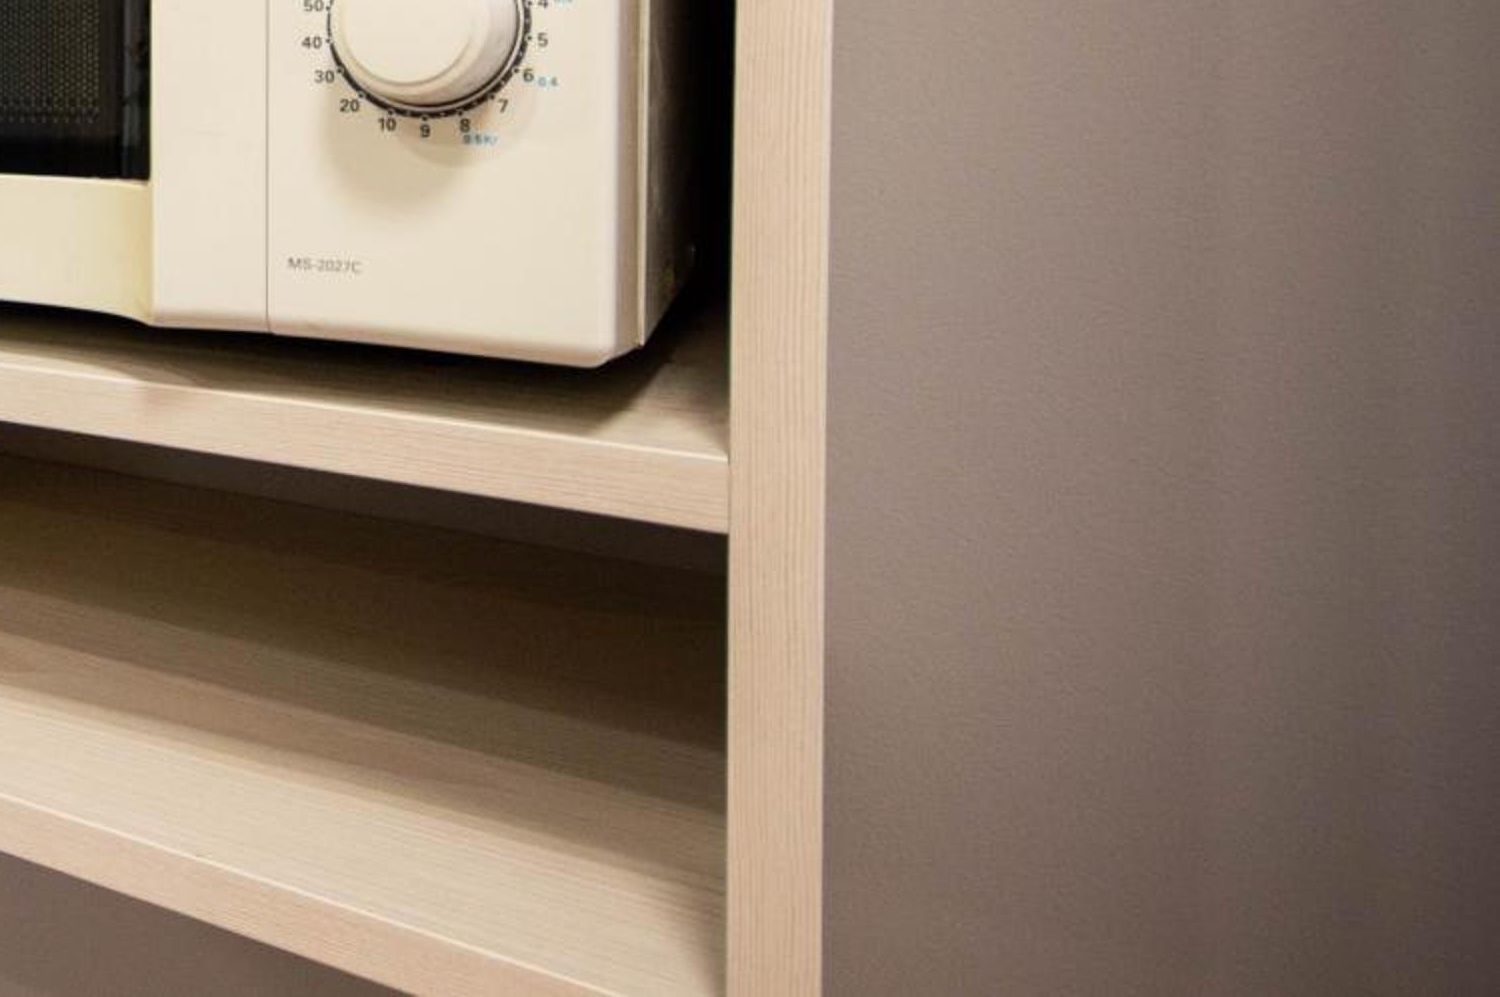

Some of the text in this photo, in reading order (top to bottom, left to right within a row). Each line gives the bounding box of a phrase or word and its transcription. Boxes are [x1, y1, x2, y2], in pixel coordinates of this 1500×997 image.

[302, 36, 322, 49] 40
[538, 33, 548, 47] 5
[314, 70, 335, 83] 30
[523, 67, 534, 82] 6
[340, 99, 360, 113] 20
[499, 98, 509, 113] 7
[378, 118, 396, 131] 10
[420, 124, 430, 138] 9
[460, 118, 470, 132] 8
